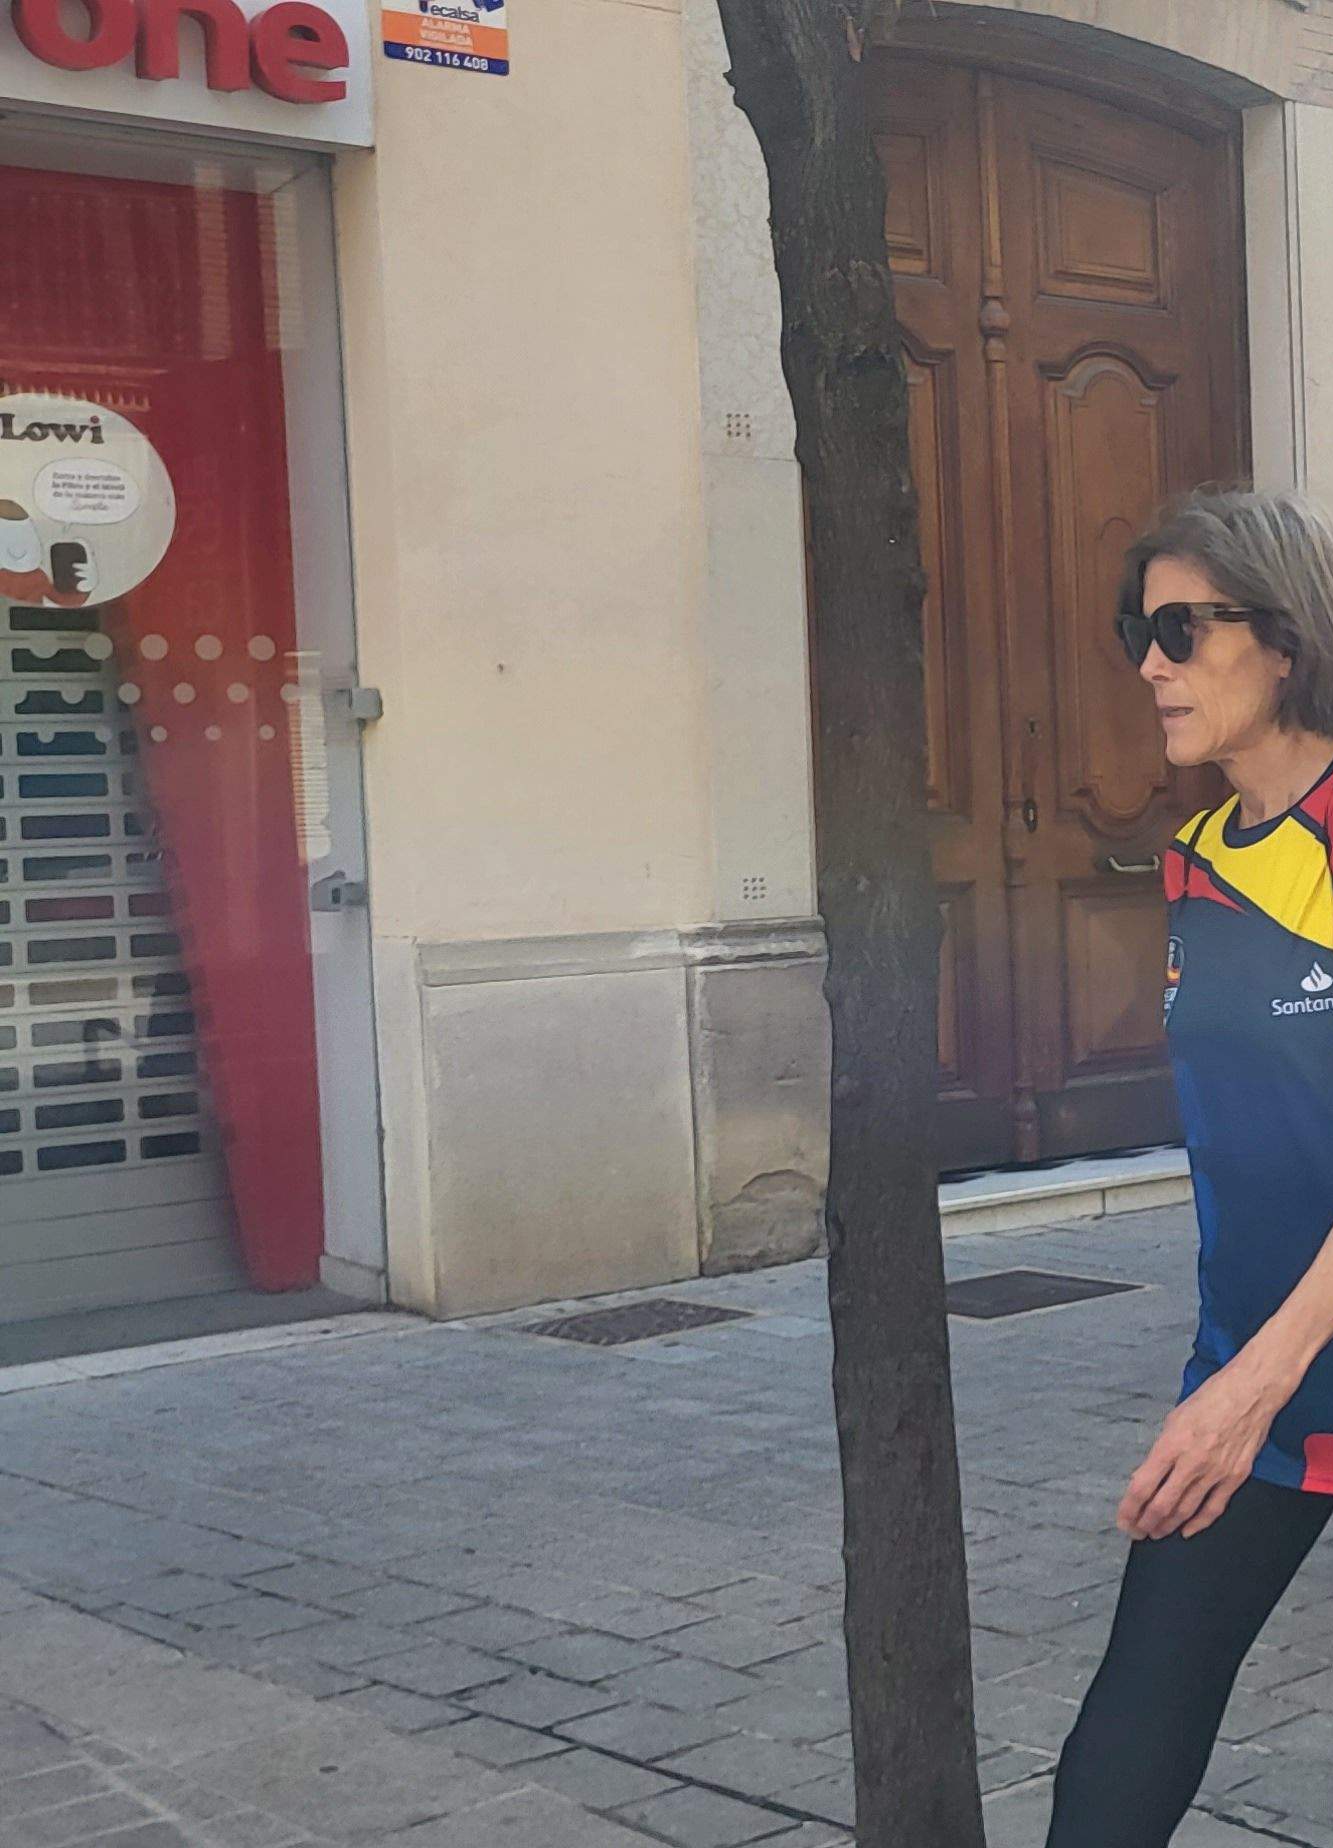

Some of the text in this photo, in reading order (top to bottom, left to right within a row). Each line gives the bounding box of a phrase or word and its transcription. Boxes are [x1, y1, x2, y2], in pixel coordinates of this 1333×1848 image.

[11, 0, 348, 103] one
[404, 46, 432, 62] 902
[435, 51, 460, 66] 116
[0, 413, 104, 444] Lowi
